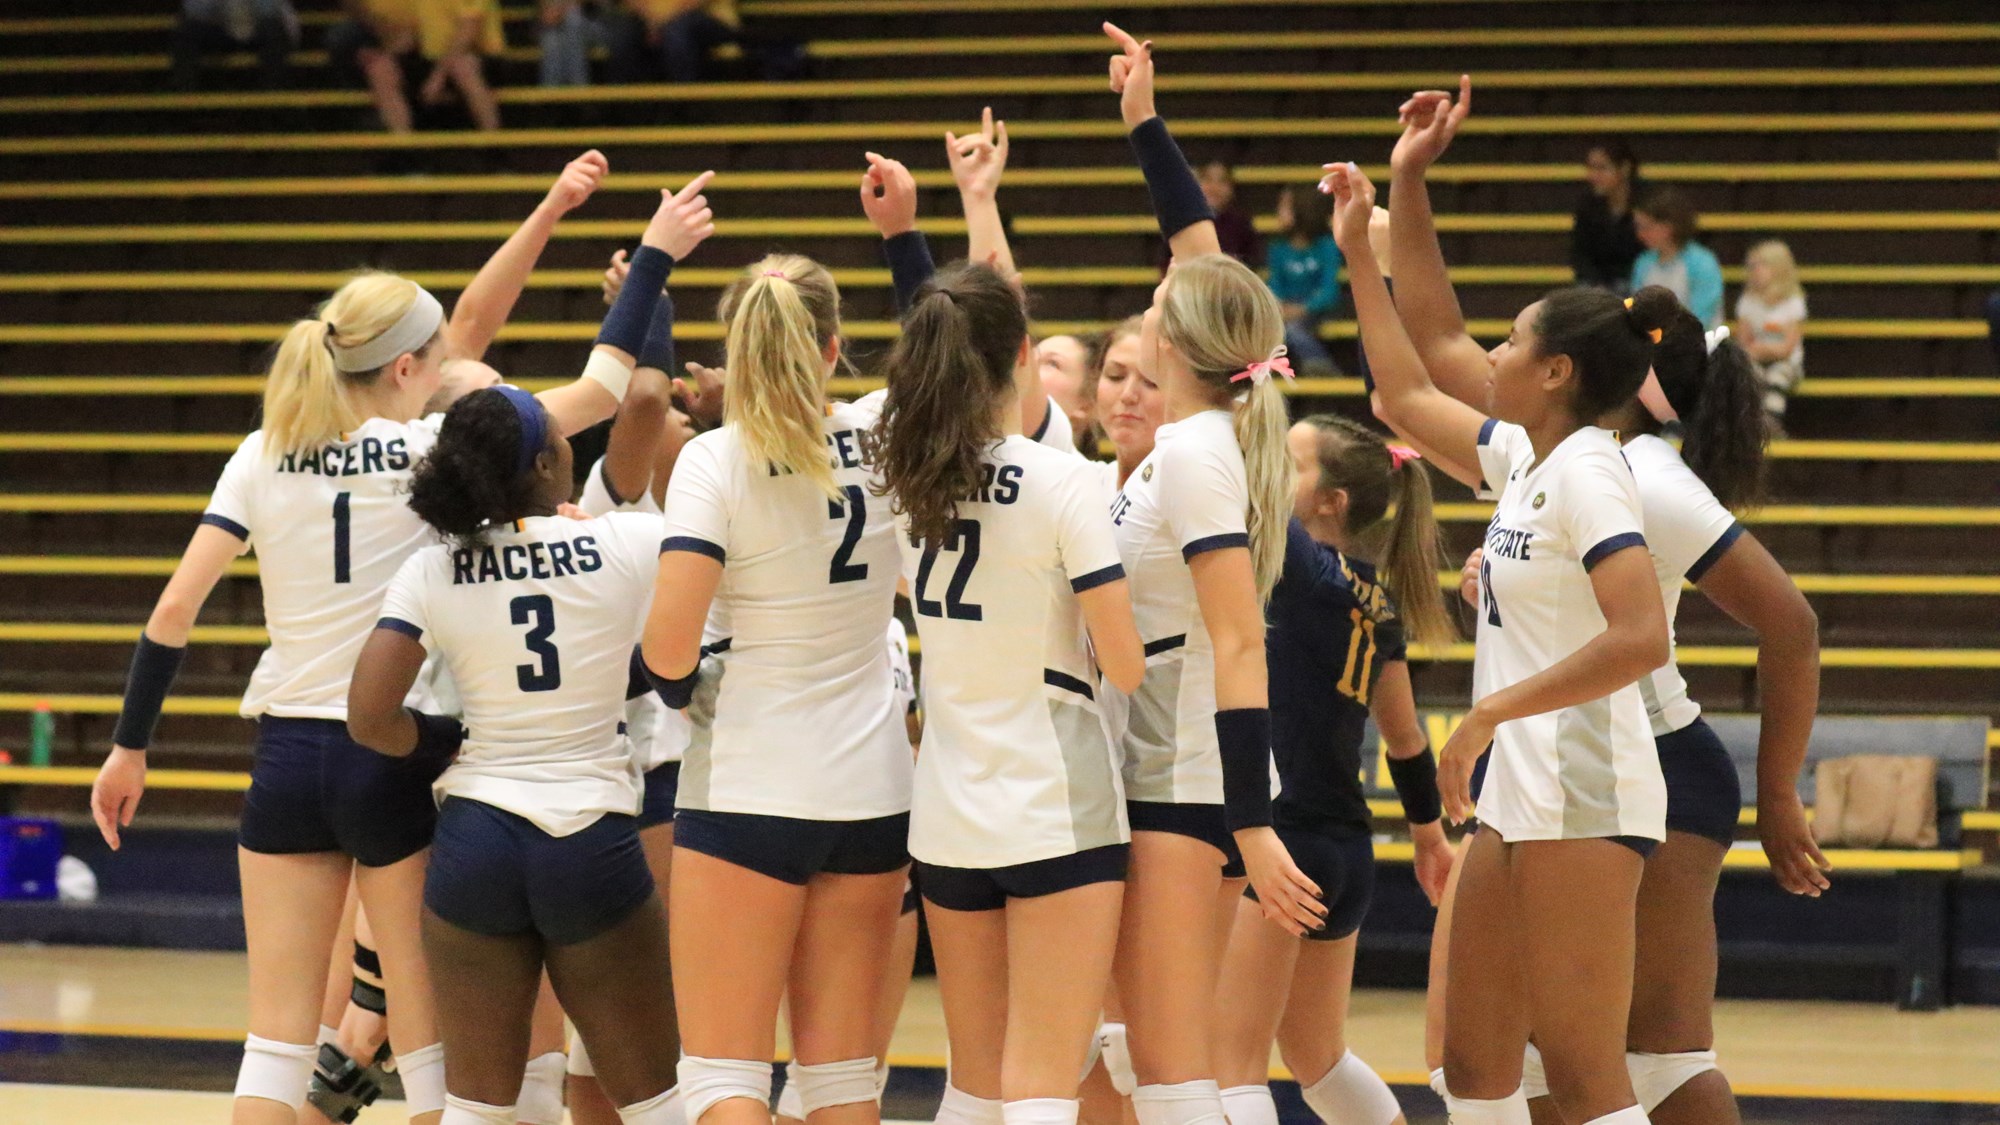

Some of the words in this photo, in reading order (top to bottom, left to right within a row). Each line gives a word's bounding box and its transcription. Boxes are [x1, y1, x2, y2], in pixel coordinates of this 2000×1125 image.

[332, 491, 351, 583] 1
[453, 535, 603, 585] RACERS
[827, 484, 868, 584] 2
[910, 518, 983, 622] 22
[509, 594, 561, 692] 3
[1336, 607, 1376, 705] 11
